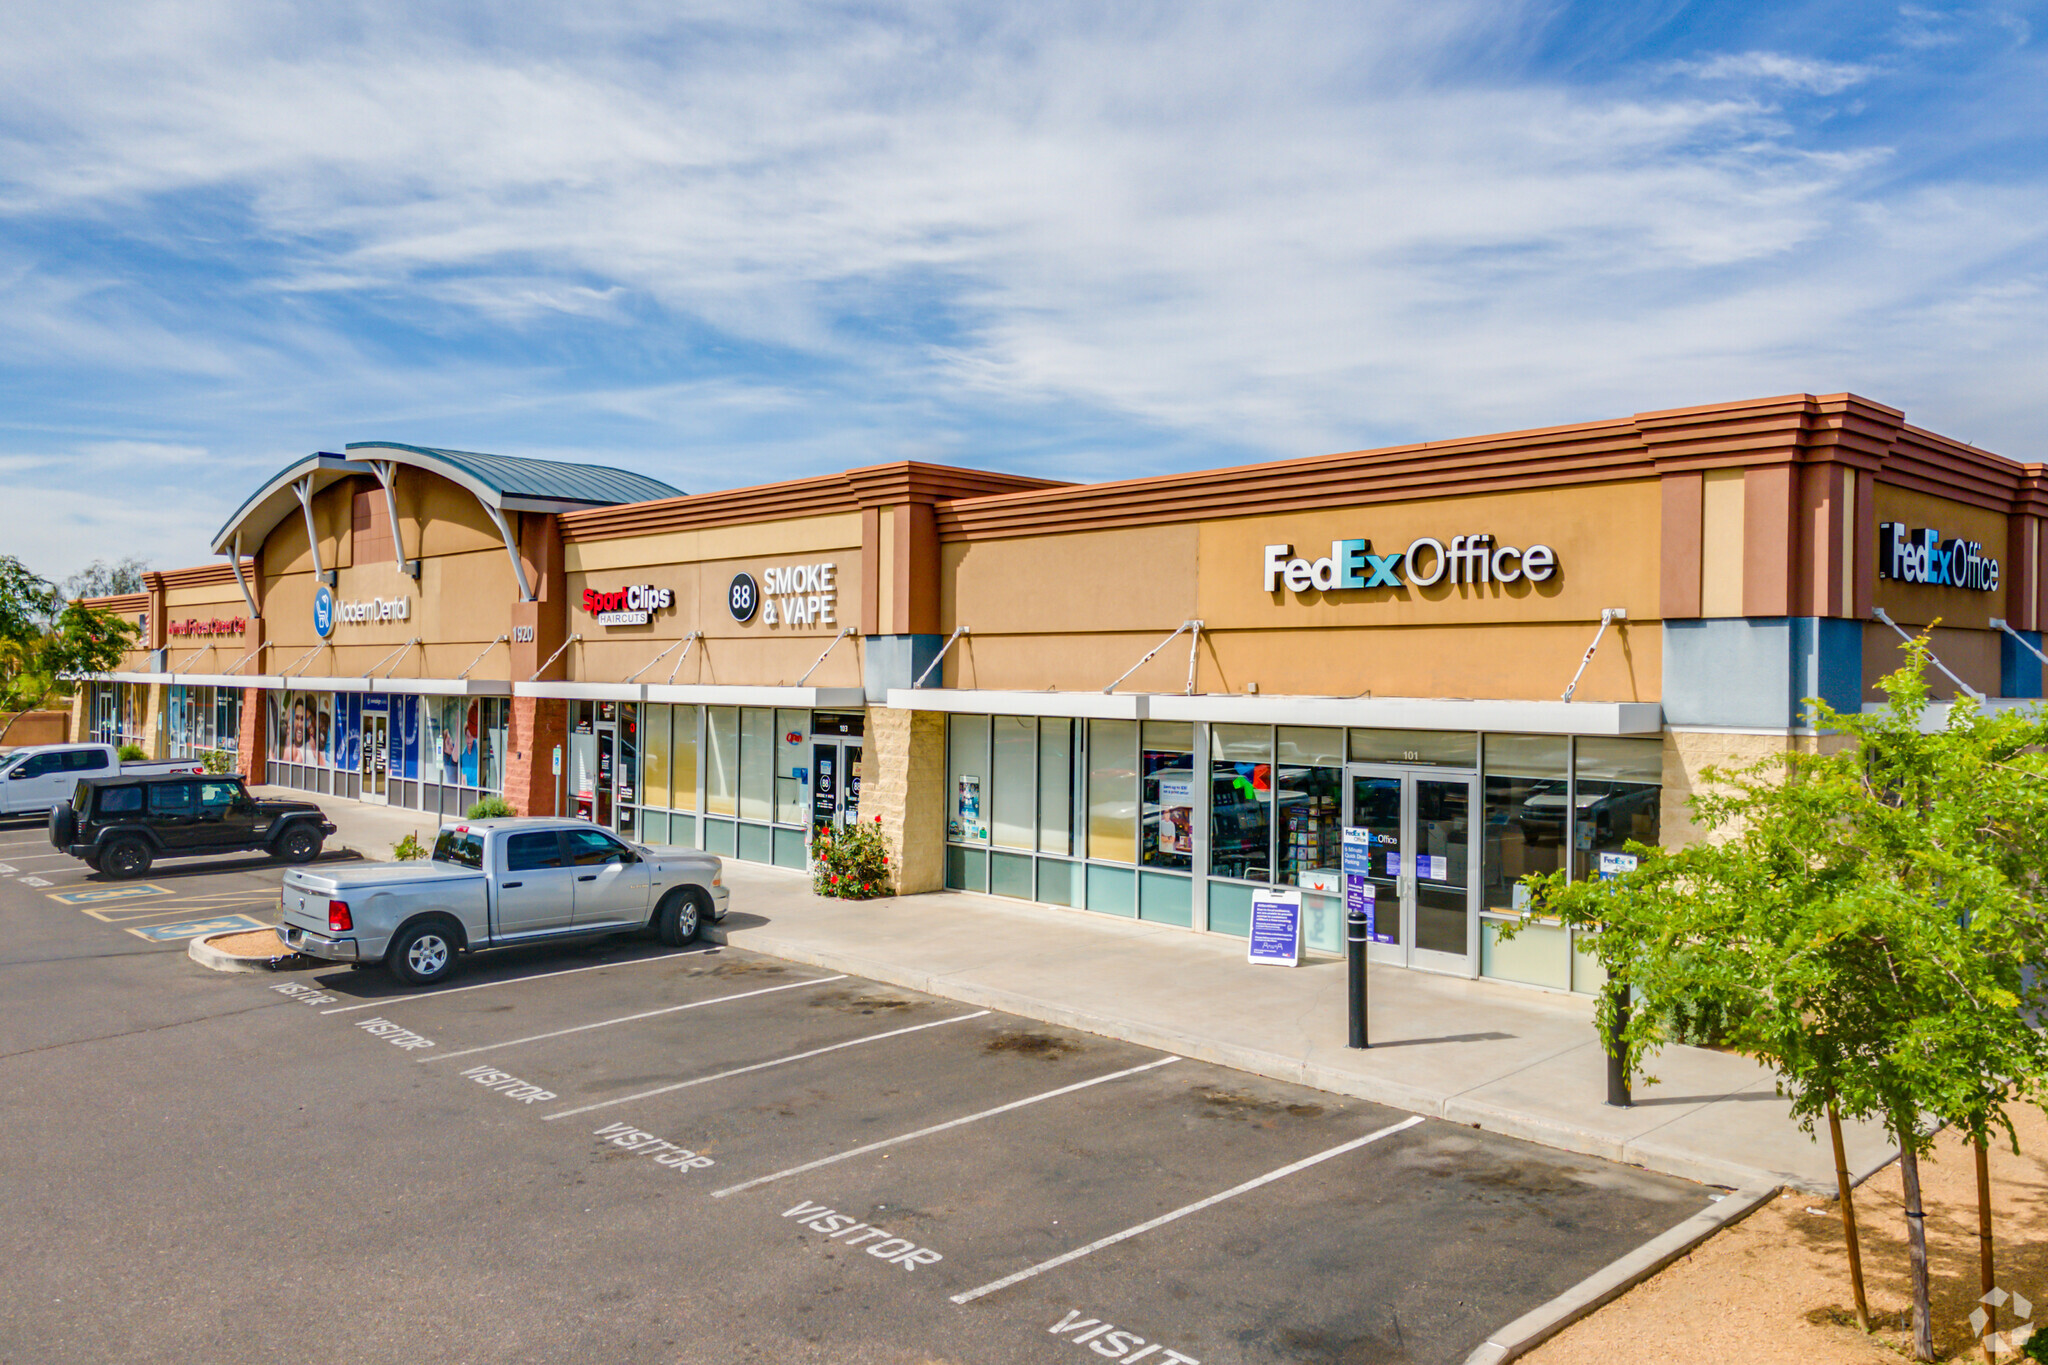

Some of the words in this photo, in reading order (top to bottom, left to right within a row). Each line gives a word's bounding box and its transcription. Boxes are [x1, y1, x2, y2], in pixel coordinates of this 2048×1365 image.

[1264, 538, 1402, 592] FedEx
[1404, 533, 1554, 587] Office
[763, 563, 834, 595] SMOKE
[732, 584, 751, 609] 88
[763, 599, 778, 624] &
[781, 595, 834, 624] VAPE
[600, 613, 646, 624] HAIRCUTS
[512, 626, 533, 642] 1920
[1403, 751, 1418, 760] 101
[1378, 834, 1397, 845] Office
[1603, 855, 1625, 865] FedEx
[355, 1017, 436, 1051] VISITOR
[459, 1065, 558, 1105] VISITOR
[592, 1121, 716, 1174] VISITOR
[780, 1200, 944, 1272] VISITOR
